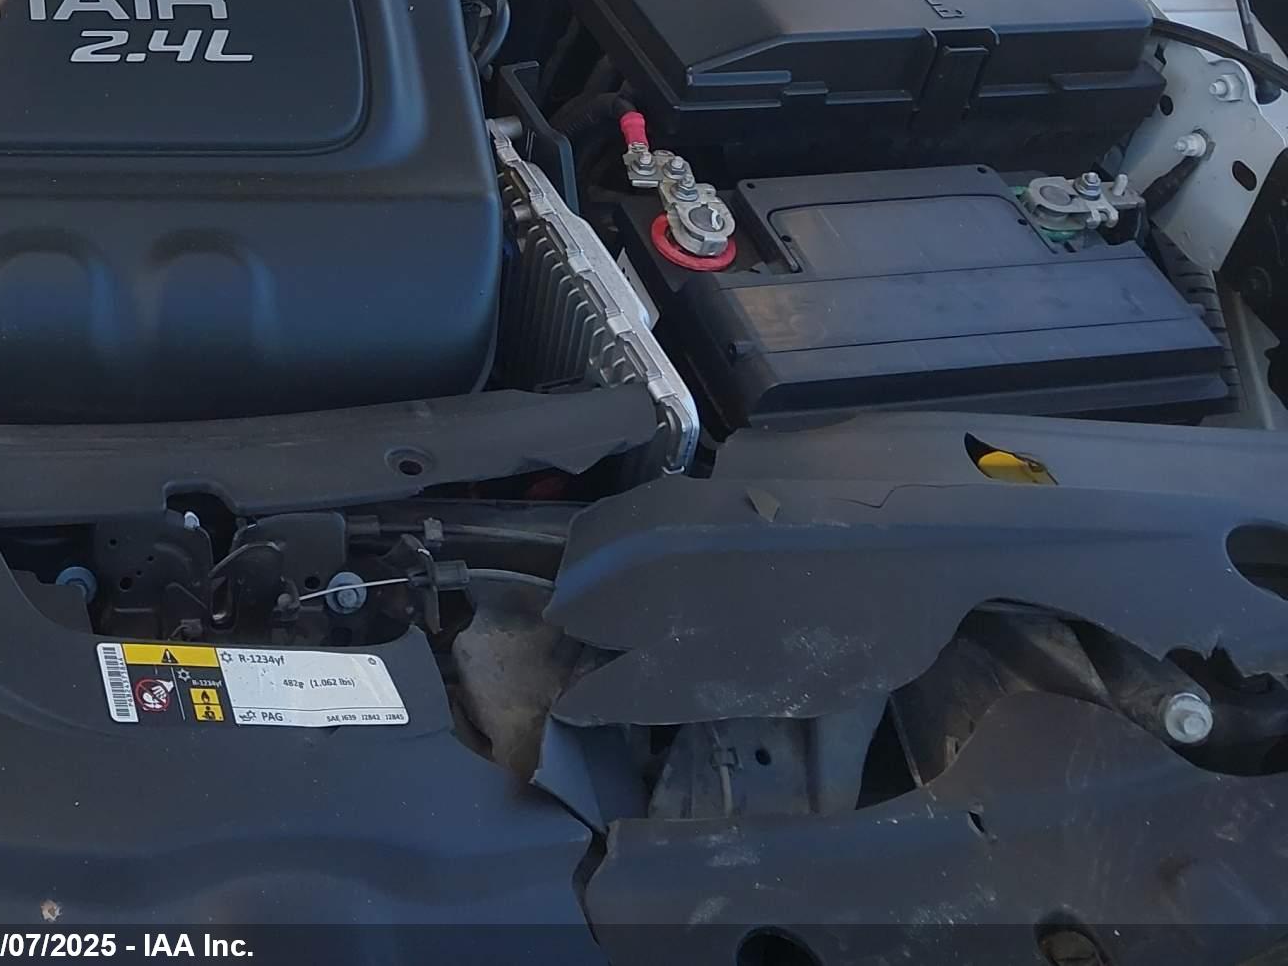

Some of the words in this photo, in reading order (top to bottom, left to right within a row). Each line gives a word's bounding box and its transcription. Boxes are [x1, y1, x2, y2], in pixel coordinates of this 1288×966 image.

[70, 29, 253, 62] 2.4L
[238, 654, 285, 666] R-1234yf
[283, 679, 305, 689] 482g
[309, 678, 338, 689] (1.062
[338, 677, 356, 688] lbs)
[261, 711, 283, 722] PAG
